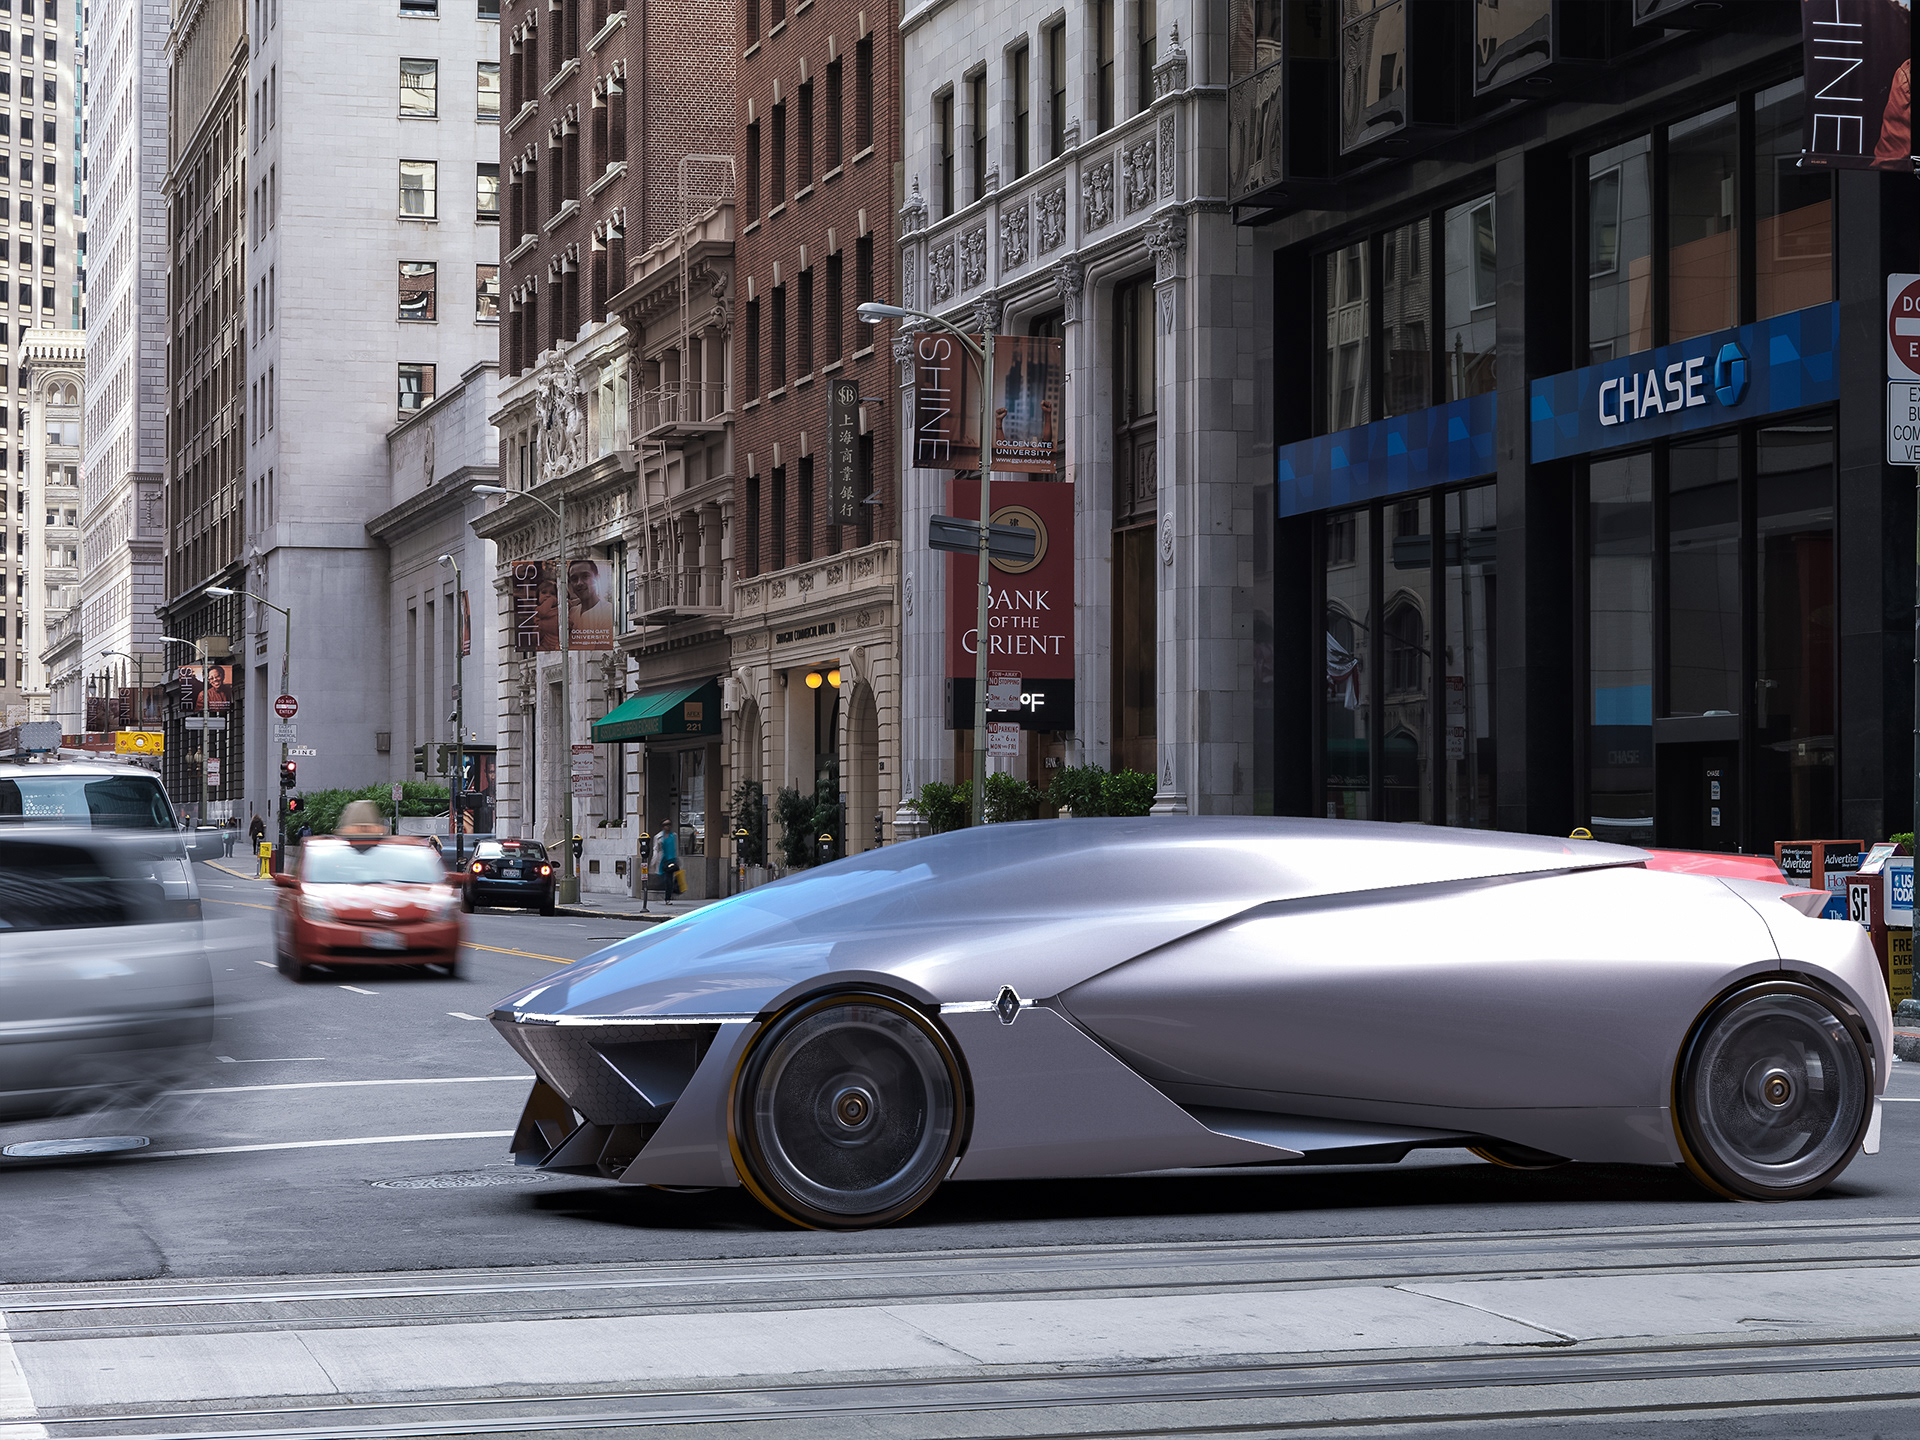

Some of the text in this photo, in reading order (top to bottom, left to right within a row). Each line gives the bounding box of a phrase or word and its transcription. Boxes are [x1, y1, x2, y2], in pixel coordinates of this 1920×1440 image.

[1598, 356, 1706, 426] CHASE
[918, 336, 951, 461] SHINE
[995, 439, 1053, 449] GOLDEN GATE
[995, 448, 1052, 457] UNIVERSITY
[838, 413, 855, 517] 上海商業銀行
[514, 564, 540, 647] SHINE
[989, 616, 1040, 628] OF THE
[961, 628, 1065, 655] ORIENT
[989, 677, 998, 685] NO
[180, 667, 194, 711] SHINE
[120, 688, 131, 725] SHINE
[686, 723, 702, 731] 221
[988, 724, 1019, 733] NO PARKING
[1782, 857, 1812, 869] Advertiser
[1893, 888, 1914, 902] TODA
[1852, 887, 1868, 921] SF
[1829, 910, 1843, 920] The
[1892, 938, 1912, 953] FRE
